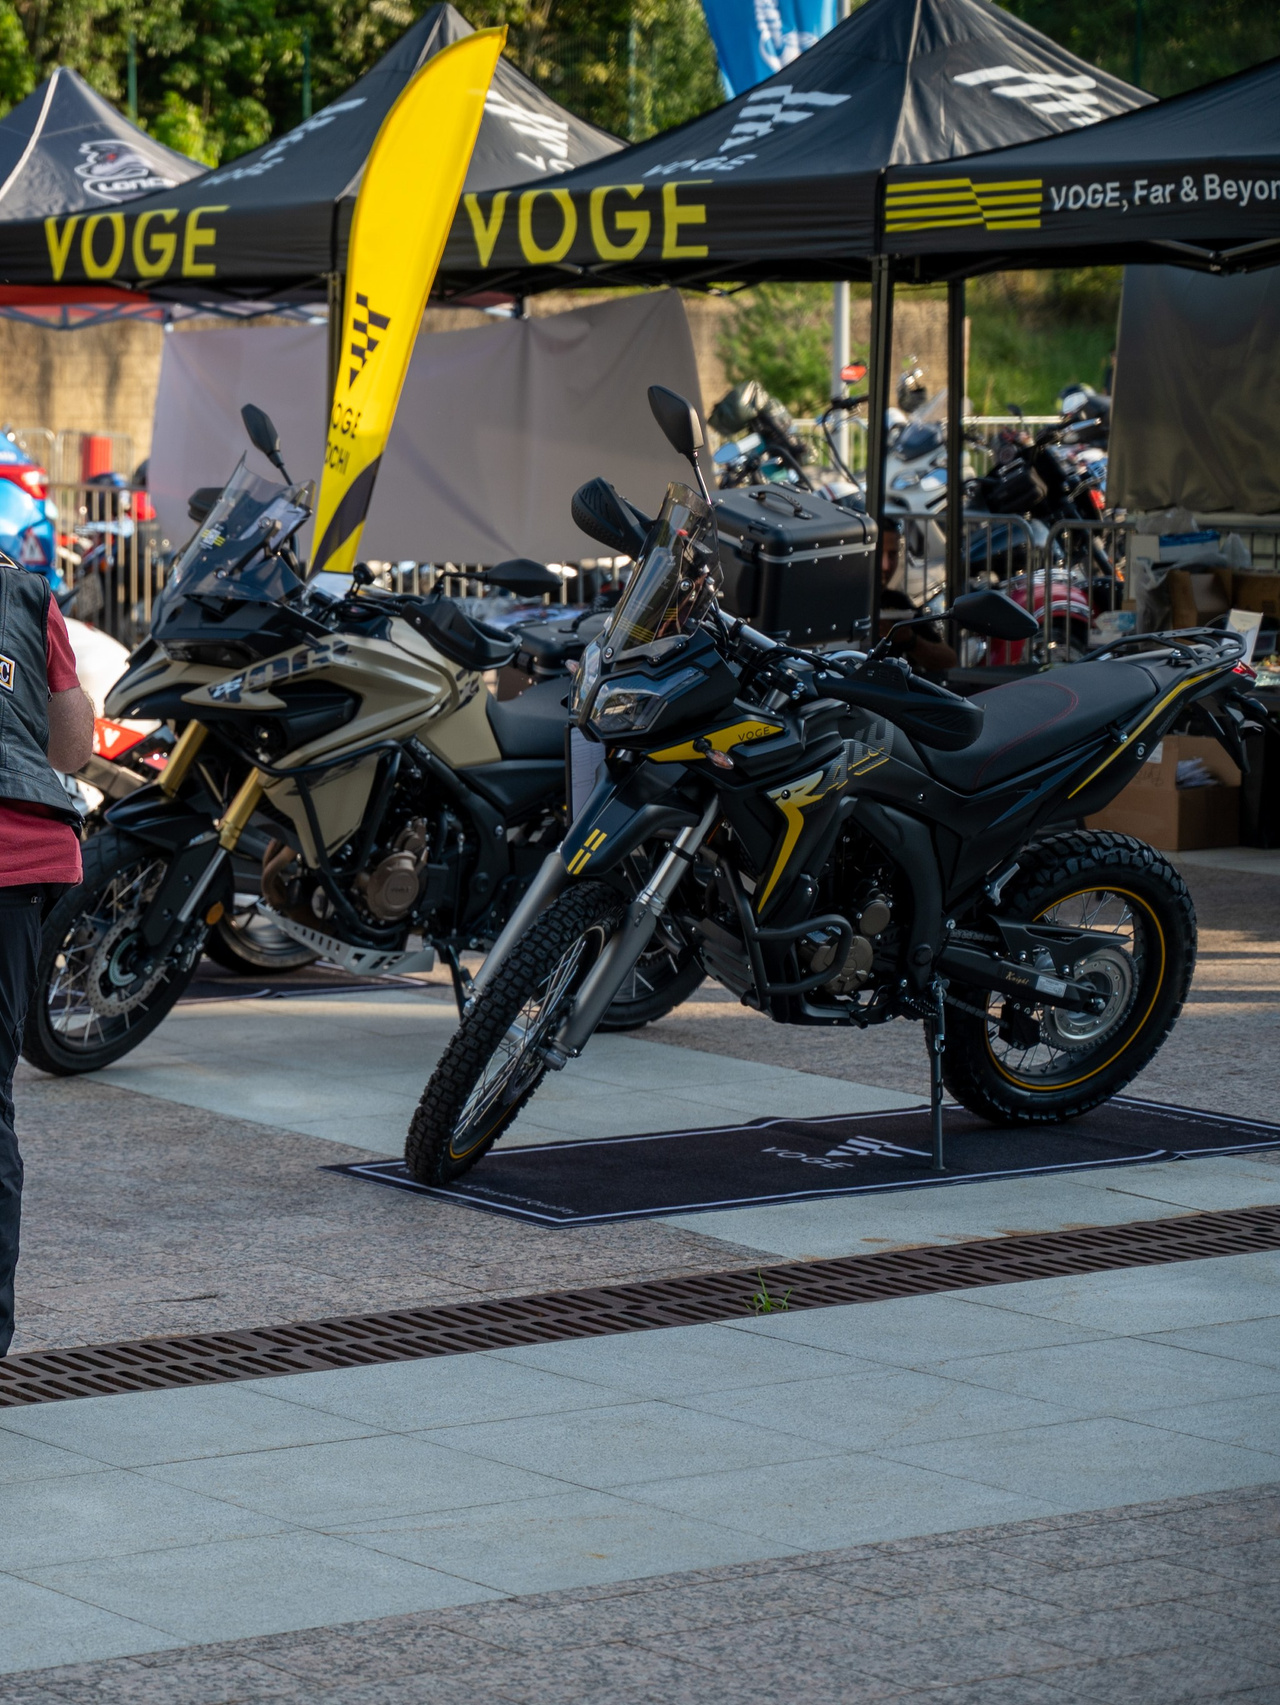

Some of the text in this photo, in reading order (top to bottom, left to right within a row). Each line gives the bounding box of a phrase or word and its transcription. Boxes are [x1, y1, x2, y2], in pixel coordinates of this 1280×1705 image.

[1050, 181, 1128, 212] VOGE,
[1134, 179, 1175, 206] Far
[1180, 175, 1199, 202] &
[463, 179, 714, 268] VOGE
[44, 204, 230, 281] VOGE
[738, 726, 770, 742] VOGE
[1005, 971, 1029, 985] Knight
[760, 1146, 855, 1169] VOGE
